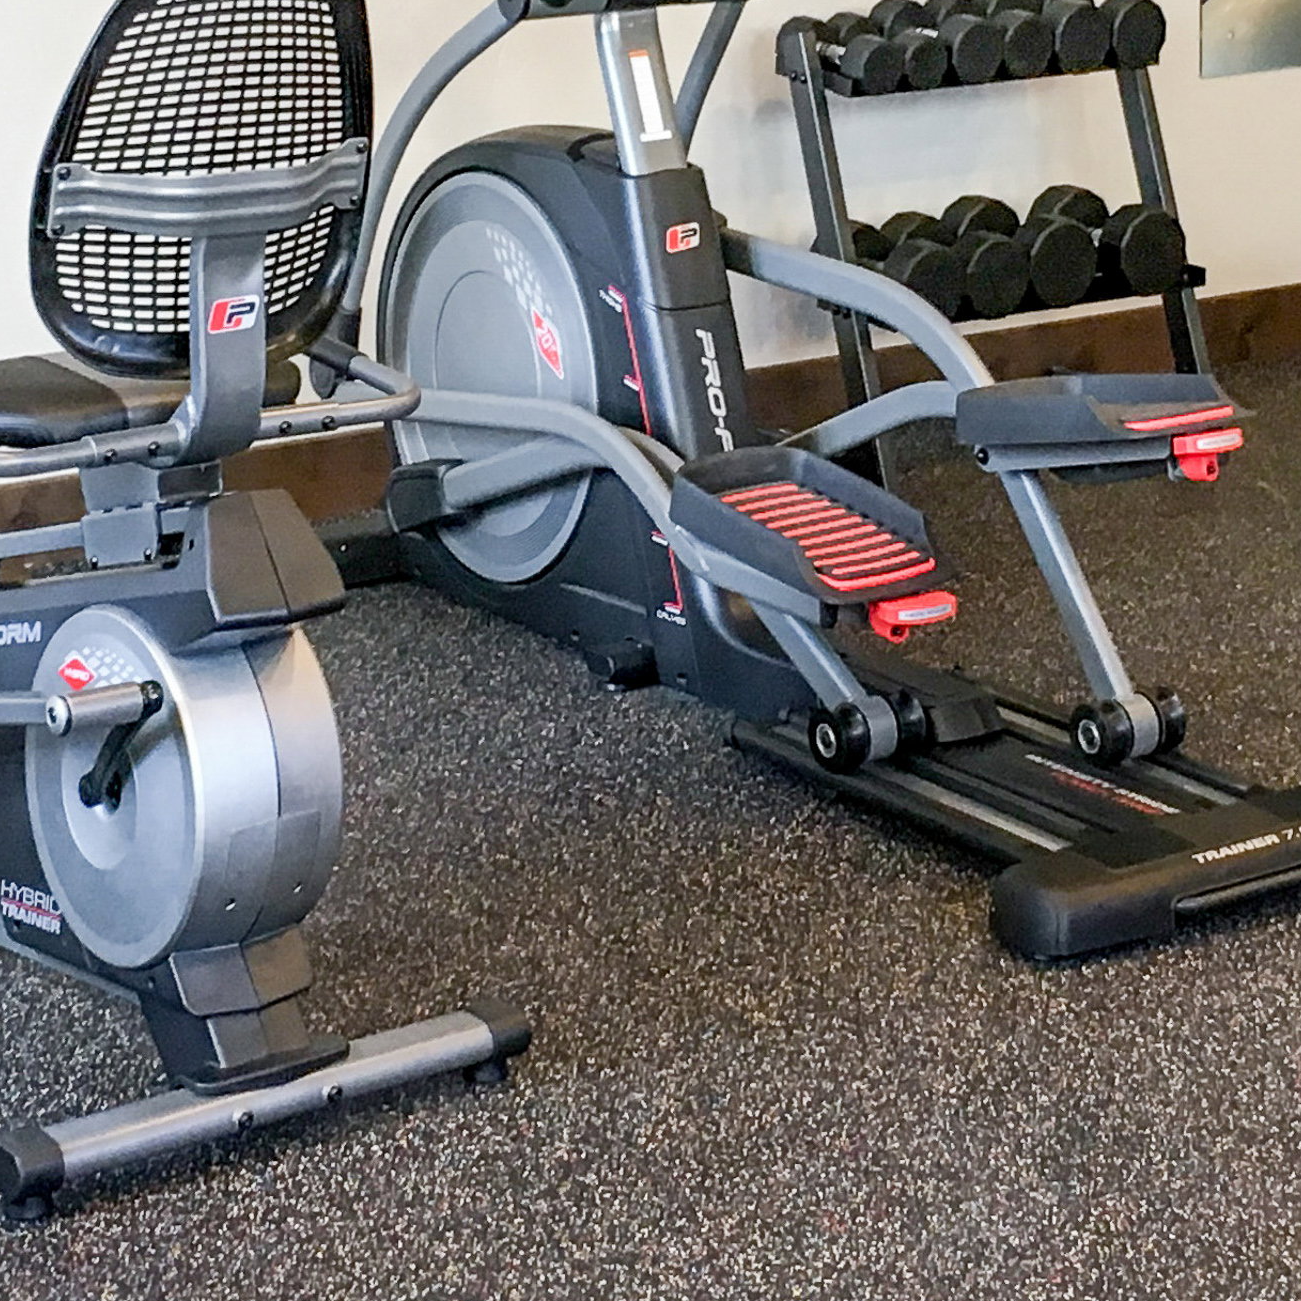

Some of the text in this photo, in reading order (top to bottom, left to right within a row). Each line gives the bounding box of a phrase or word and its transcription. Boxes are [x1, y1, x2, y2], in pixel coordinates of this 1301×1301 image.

[695, 328, 735, 452] PRO-F
[1191, 833, 1281, 864] TRAINER
[0, 879, 62, 915] HYBRID
[0, 900, 62, 935] TRAINER
